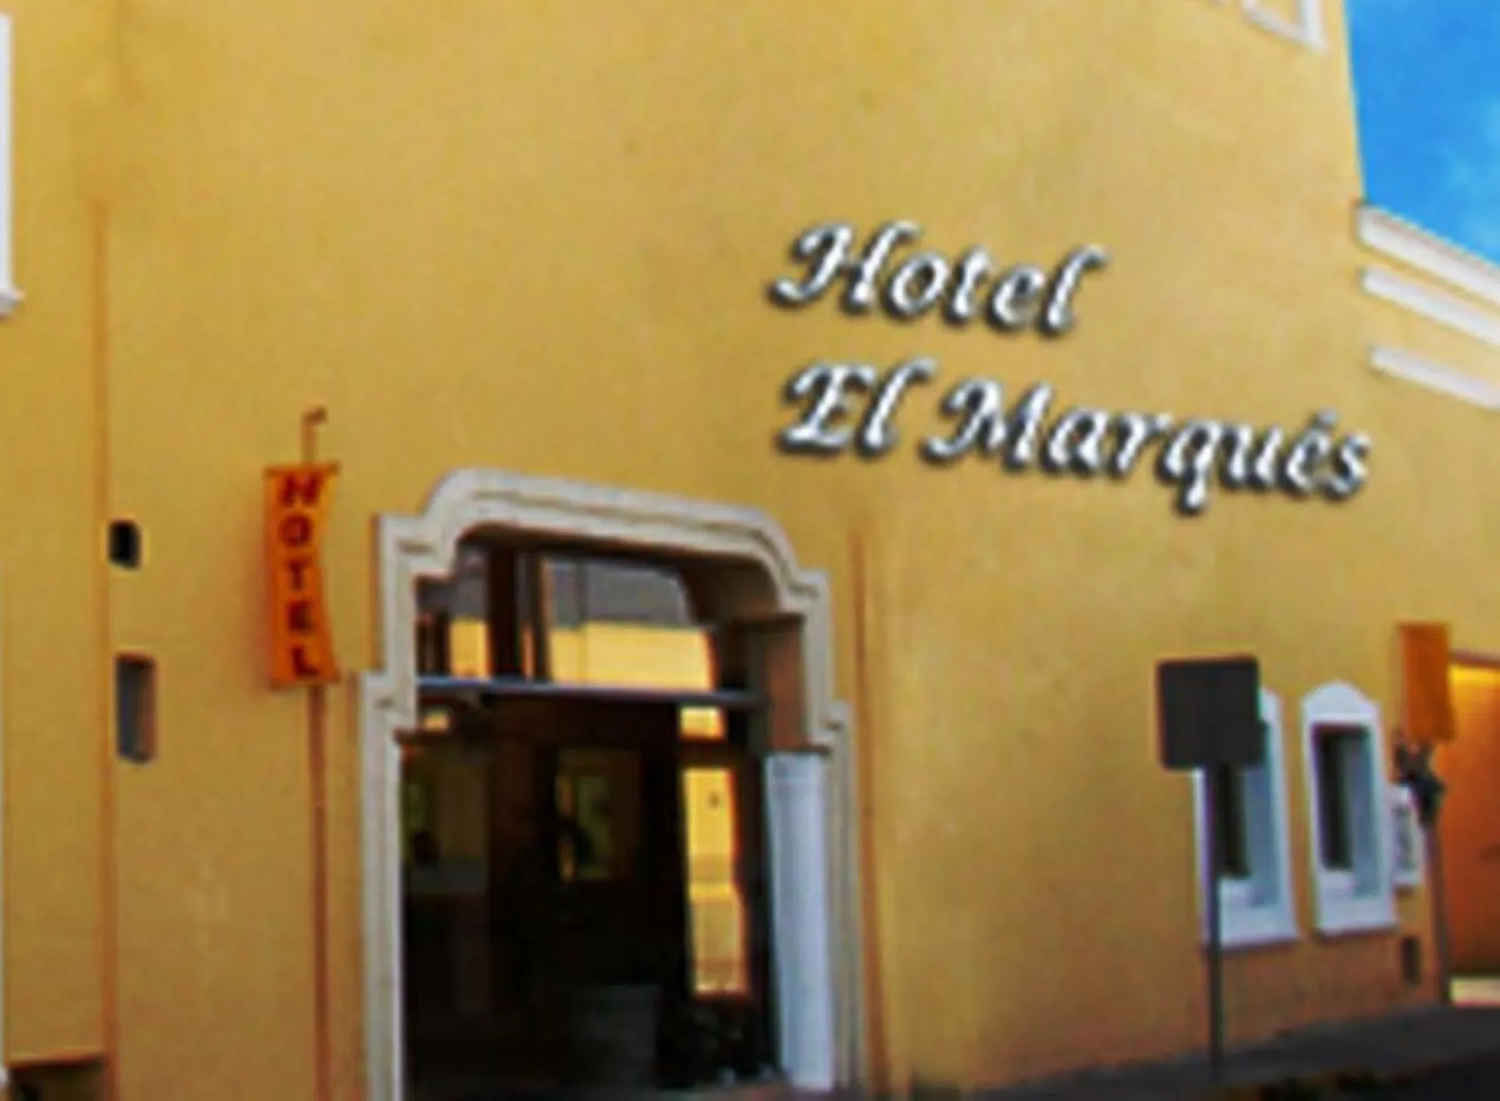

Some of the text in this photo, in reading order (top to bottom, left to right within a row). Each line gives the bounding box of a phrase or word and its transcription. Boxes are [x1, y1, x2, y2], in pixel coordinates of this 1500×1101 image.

[768, 220, 1106, 331] Hotel
[777, 357, 936, 455] El
[278, 470, 321, 679] HOTEL
